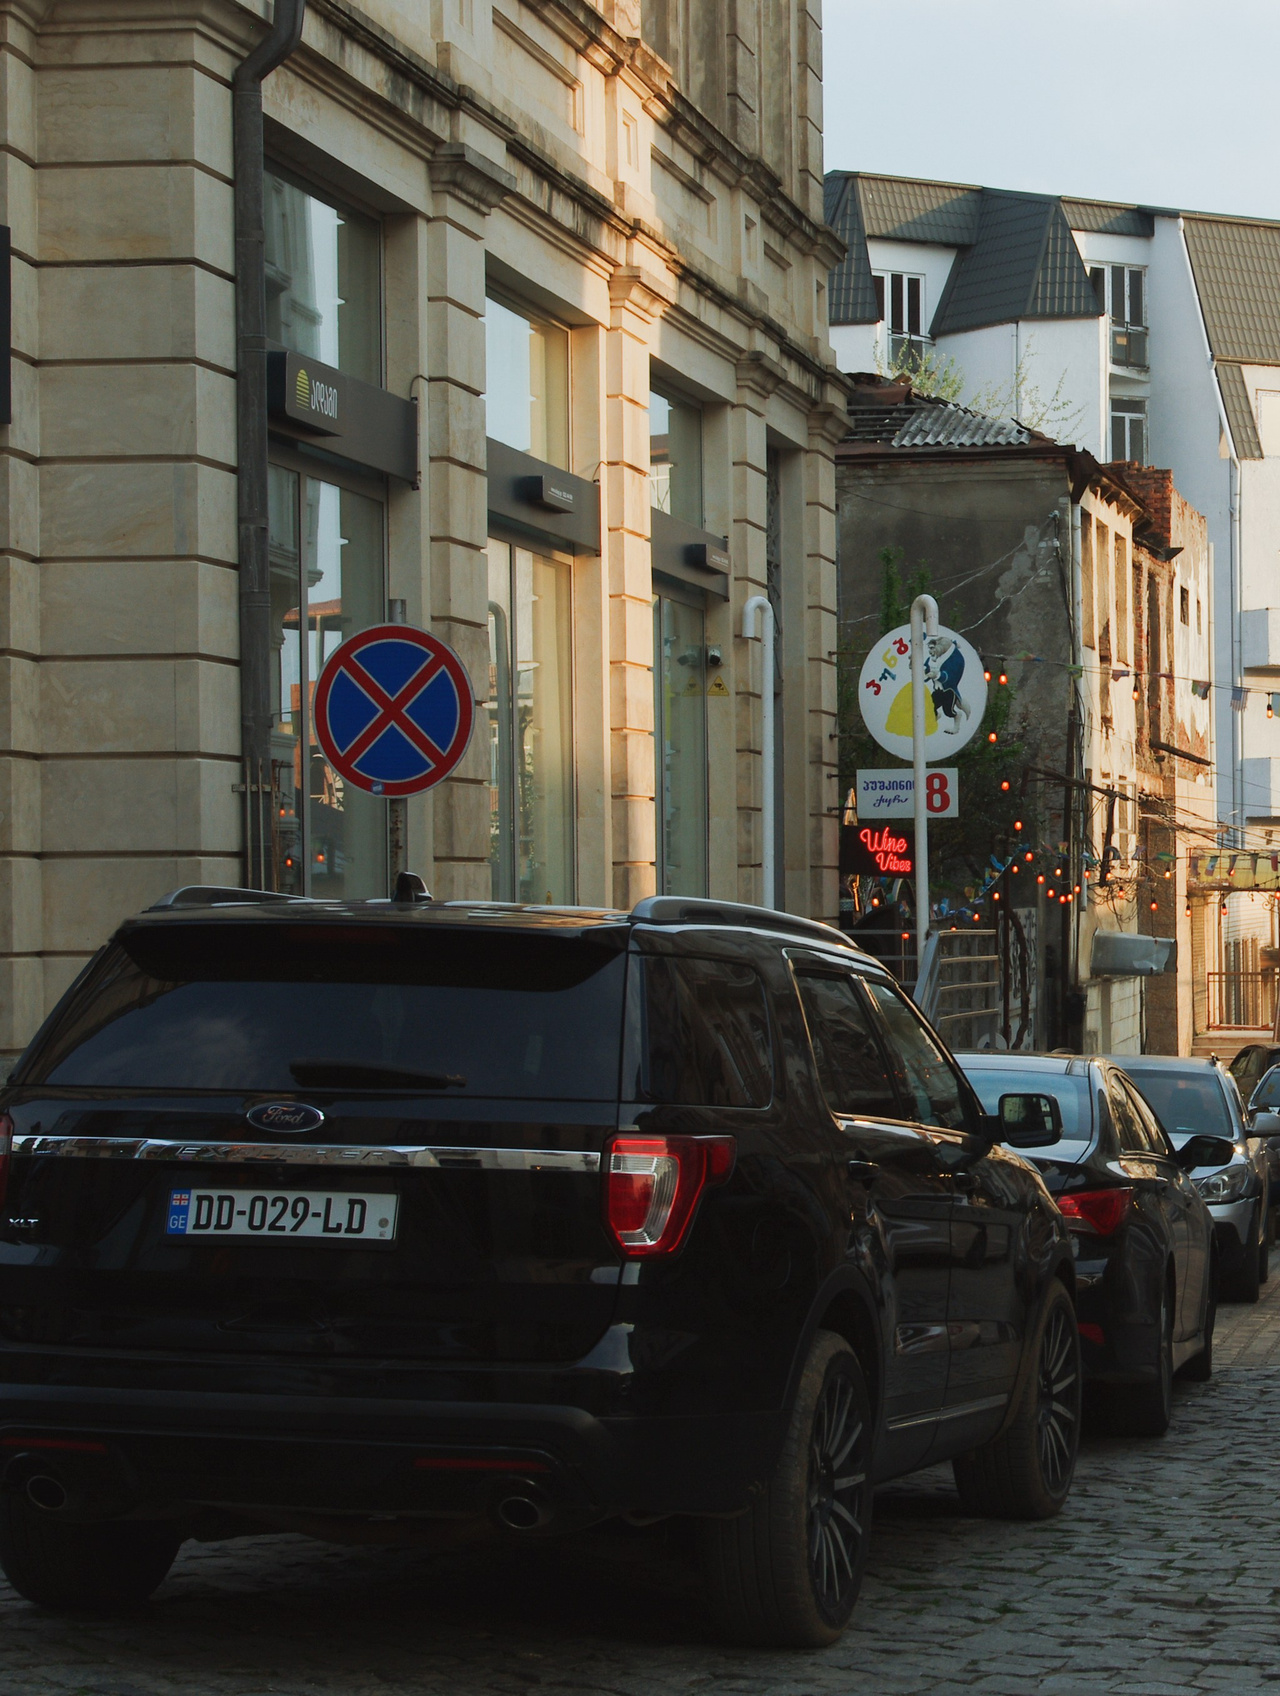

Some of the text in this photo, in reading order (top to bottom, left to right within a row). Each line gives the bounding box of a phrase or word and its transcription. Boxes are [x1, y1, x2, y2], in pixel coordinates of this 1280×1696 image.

[863, 780, 915, 791] პუშკინი
[926, 772, 951, 813] 8
[860, 826, 908, 853] Wine
[876, 852, 912, 872] Vibes
[262, 1105, 305, 1126] Ford
[169, 1215, 186, 1229] GE
[192, 1194, 367, 1234] DD-029-LD
